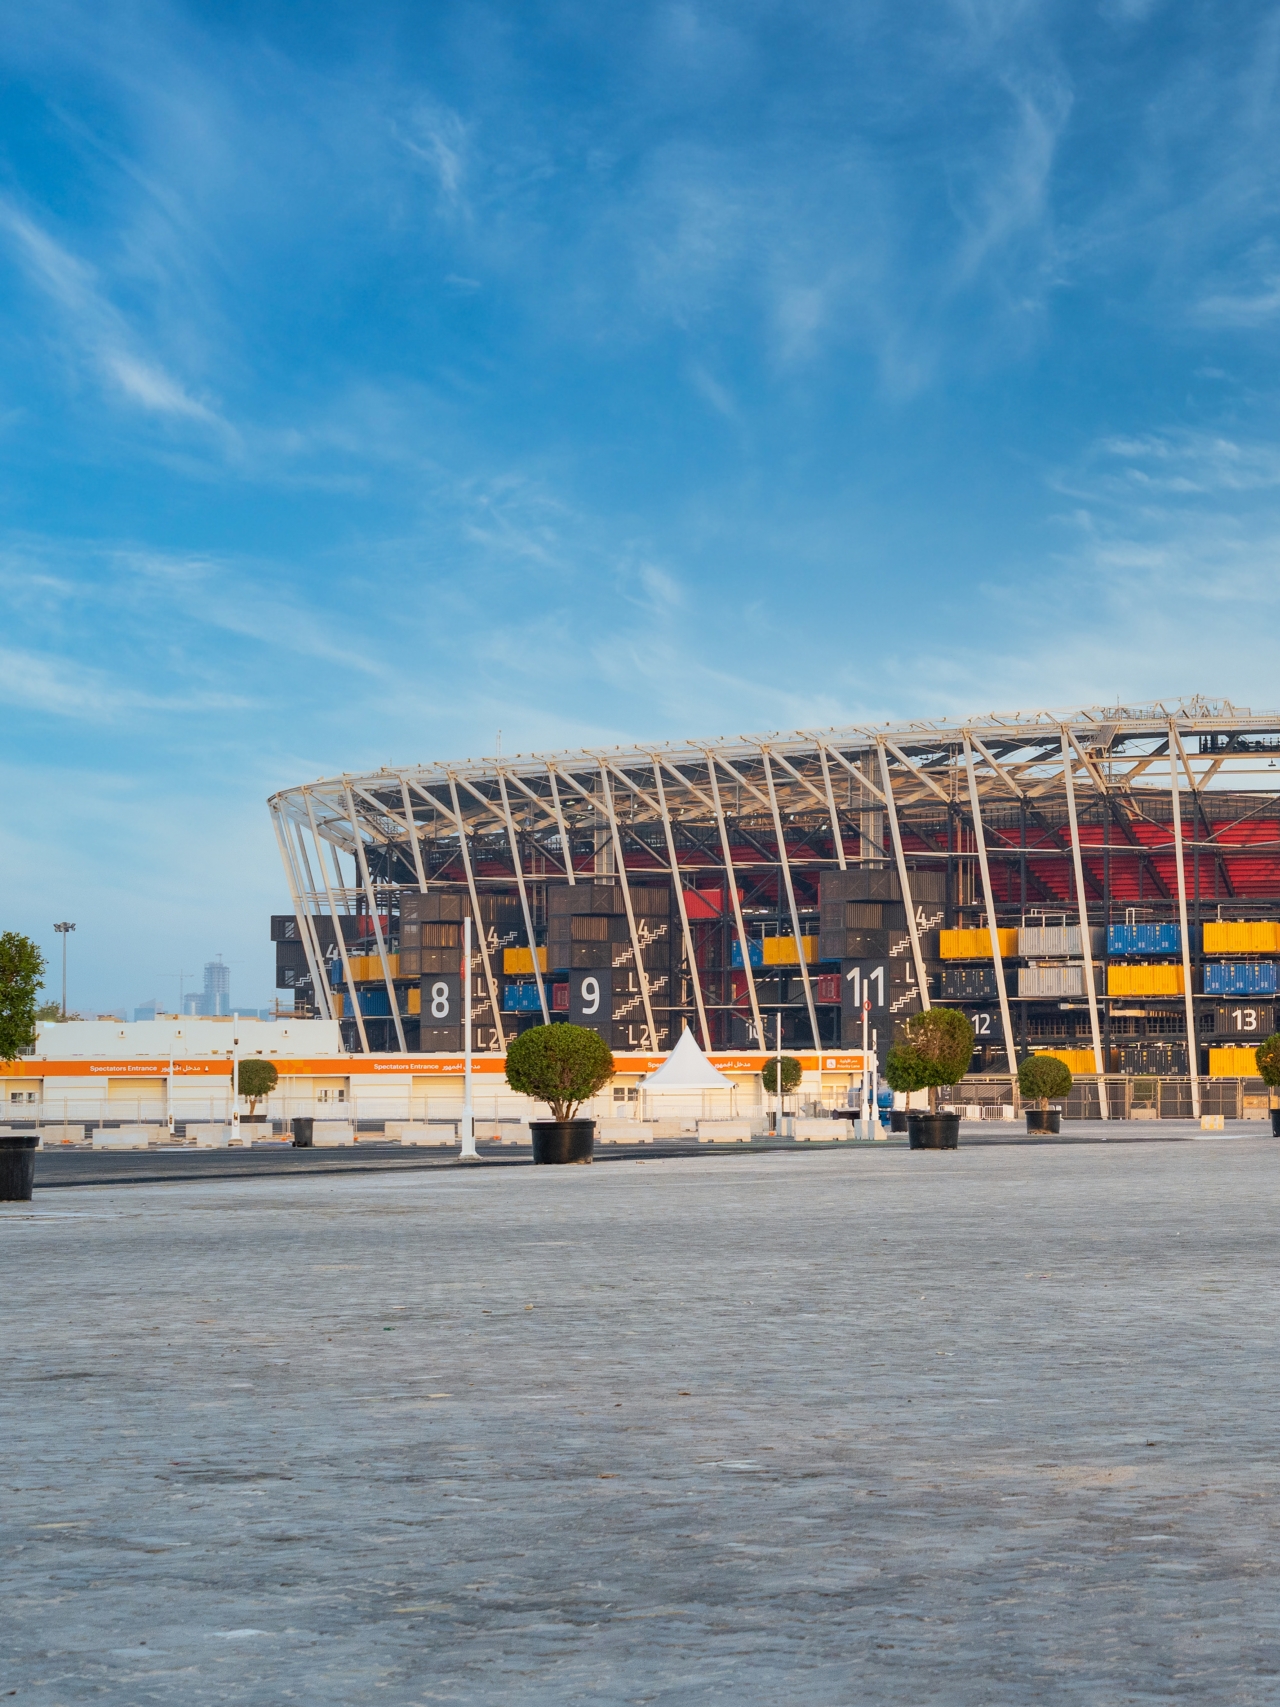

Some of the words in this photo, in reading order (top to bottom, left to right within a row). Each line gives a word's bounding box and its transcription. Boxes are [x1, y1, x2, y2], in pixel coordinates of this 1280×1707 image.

[581, 976, 600, 1014] 9
[846, 966, 884, 1007] 11
[431, 982, 449, 1018] 8
[971, 1013, 991, 1035] 12
[1231, 1009, 1257, 1030] 13
[477, 1028, 499, 1048] L2
[628, 1025, 650, 1045] L2
[89, 1065, 126, 1073] Spectators
